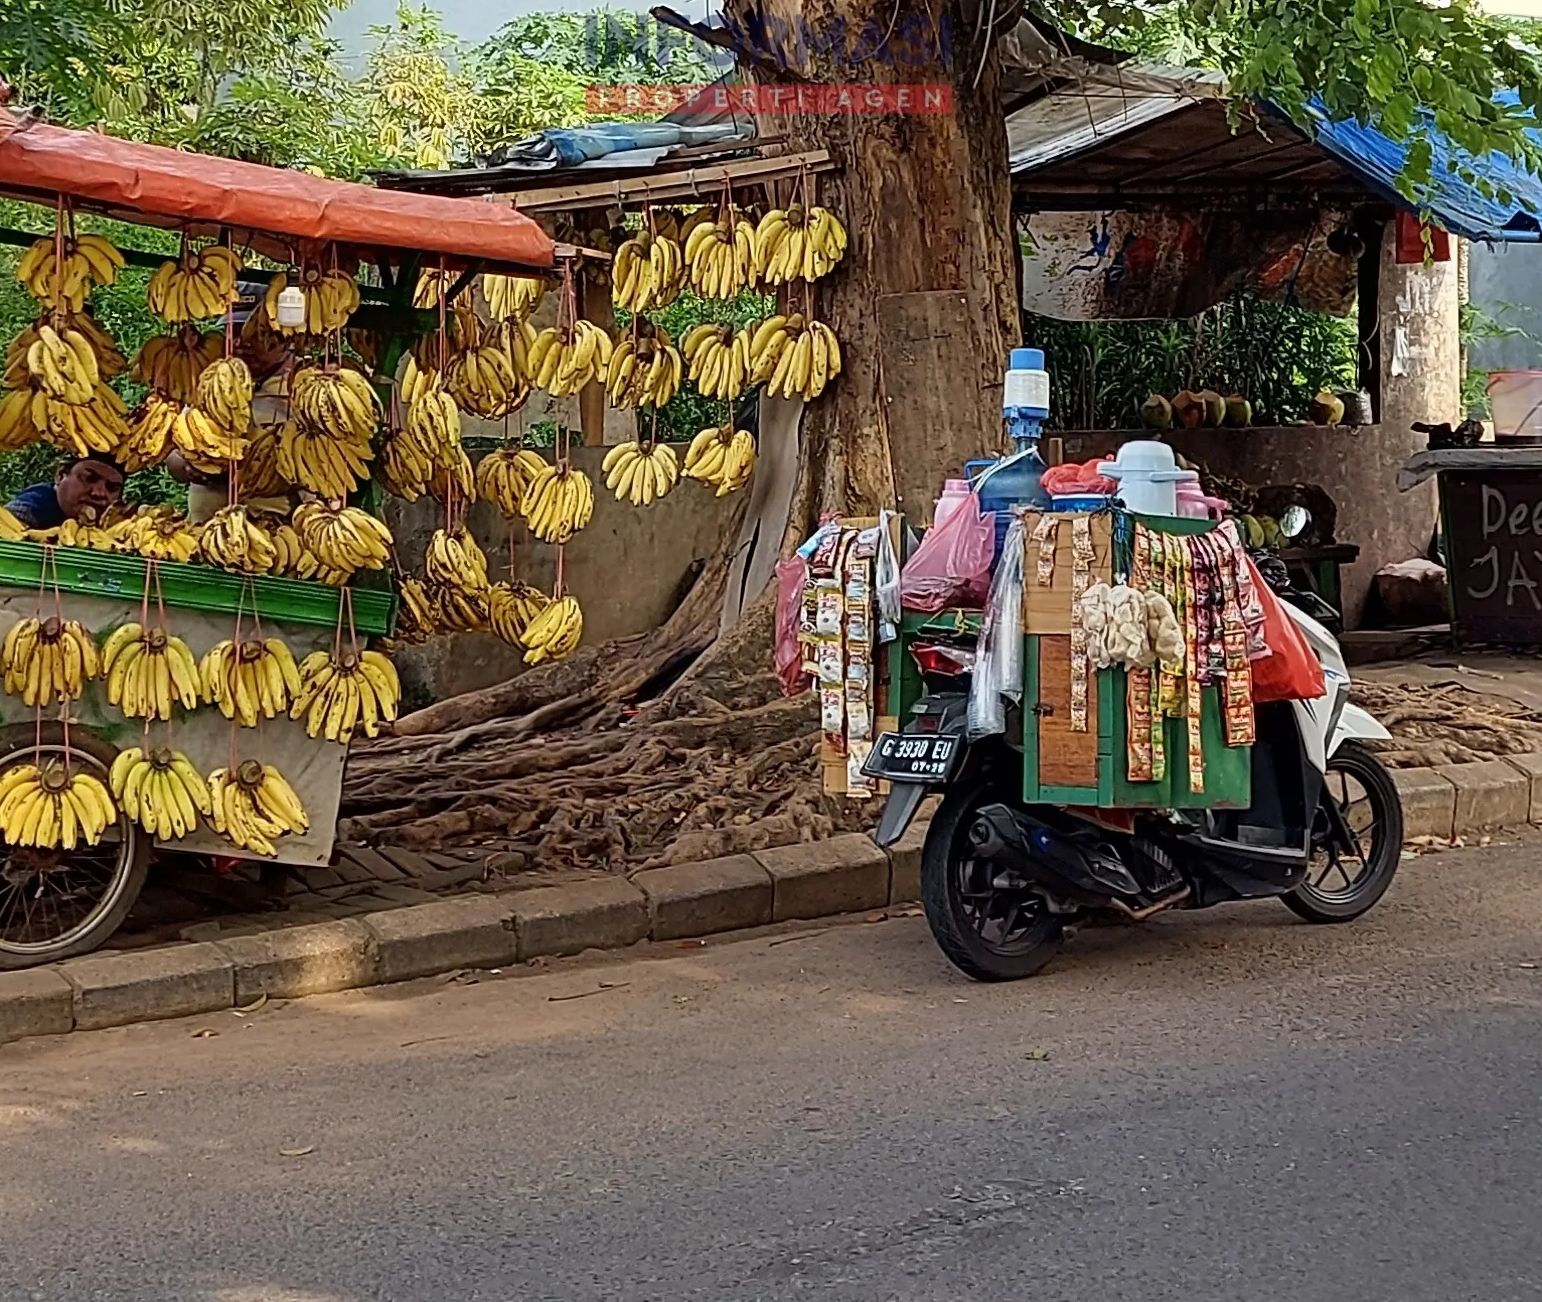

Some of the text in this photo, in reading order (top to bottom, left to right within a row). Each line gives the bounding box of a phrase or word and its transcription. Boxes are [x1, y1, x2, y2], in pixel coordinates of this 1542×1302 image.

[881, 739, 952, 759] G 3930 EU
